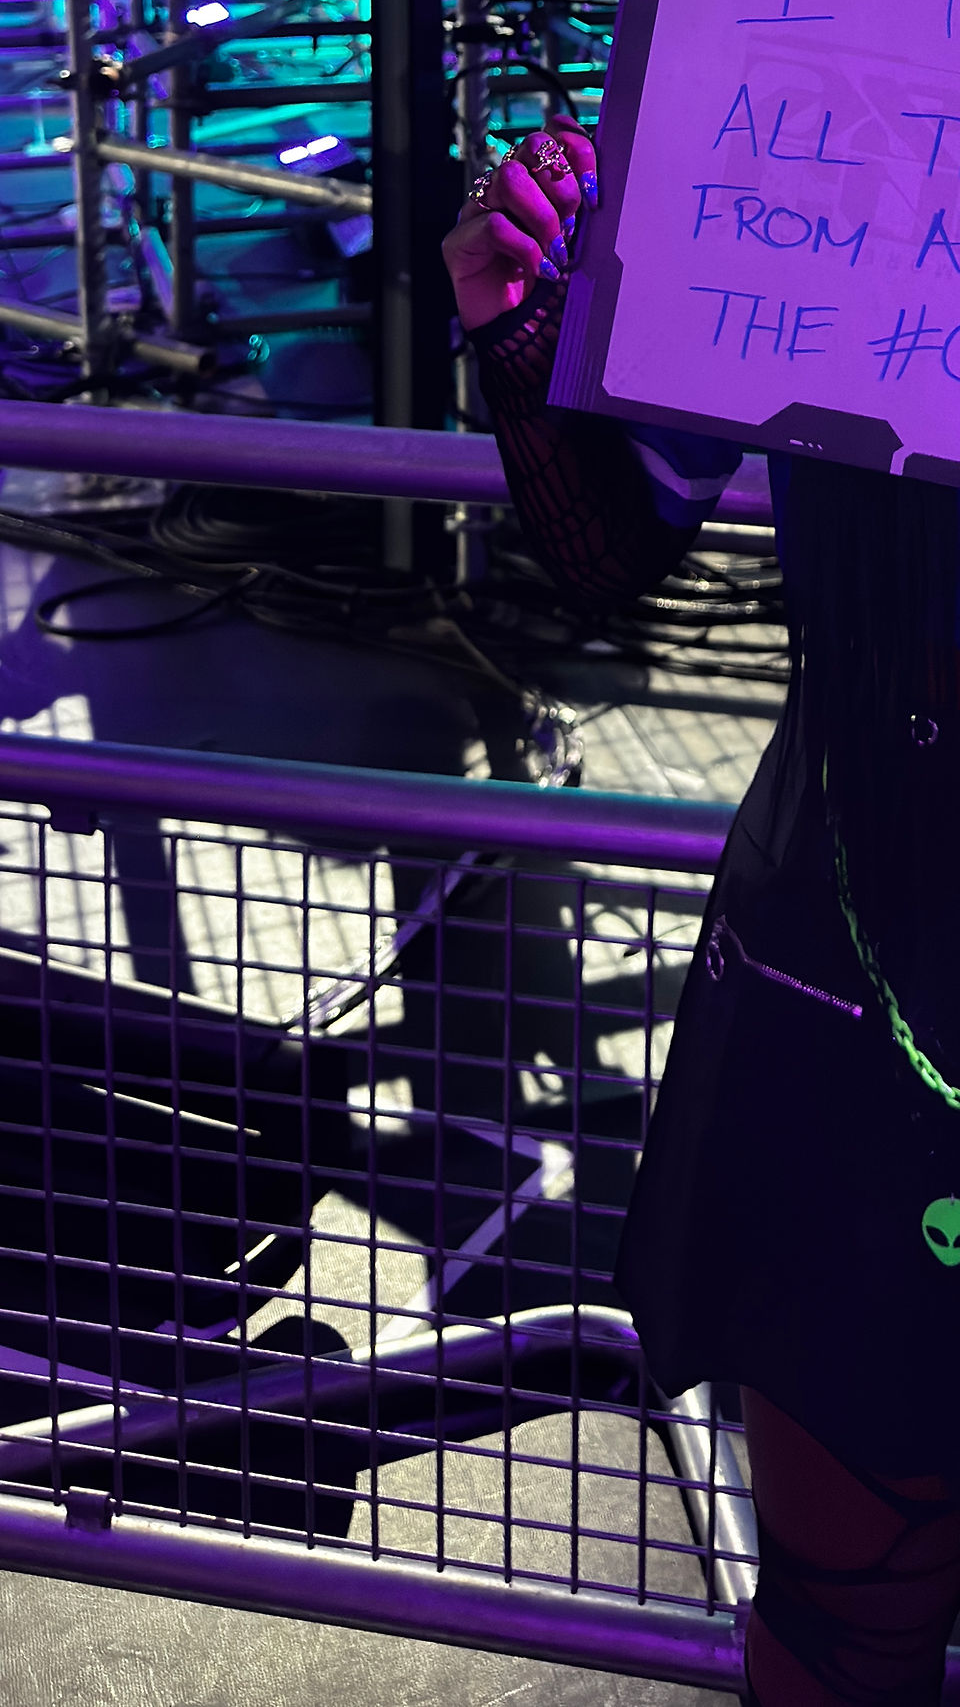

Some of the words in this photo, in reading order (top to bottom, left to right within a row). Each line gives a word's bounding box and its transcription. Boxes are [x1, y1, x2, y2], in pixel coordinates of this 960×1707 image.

[712, 83, 865, 165] ALL
[692, 184, 869, 267] FROM
[688, 286, 839, 361] THE
